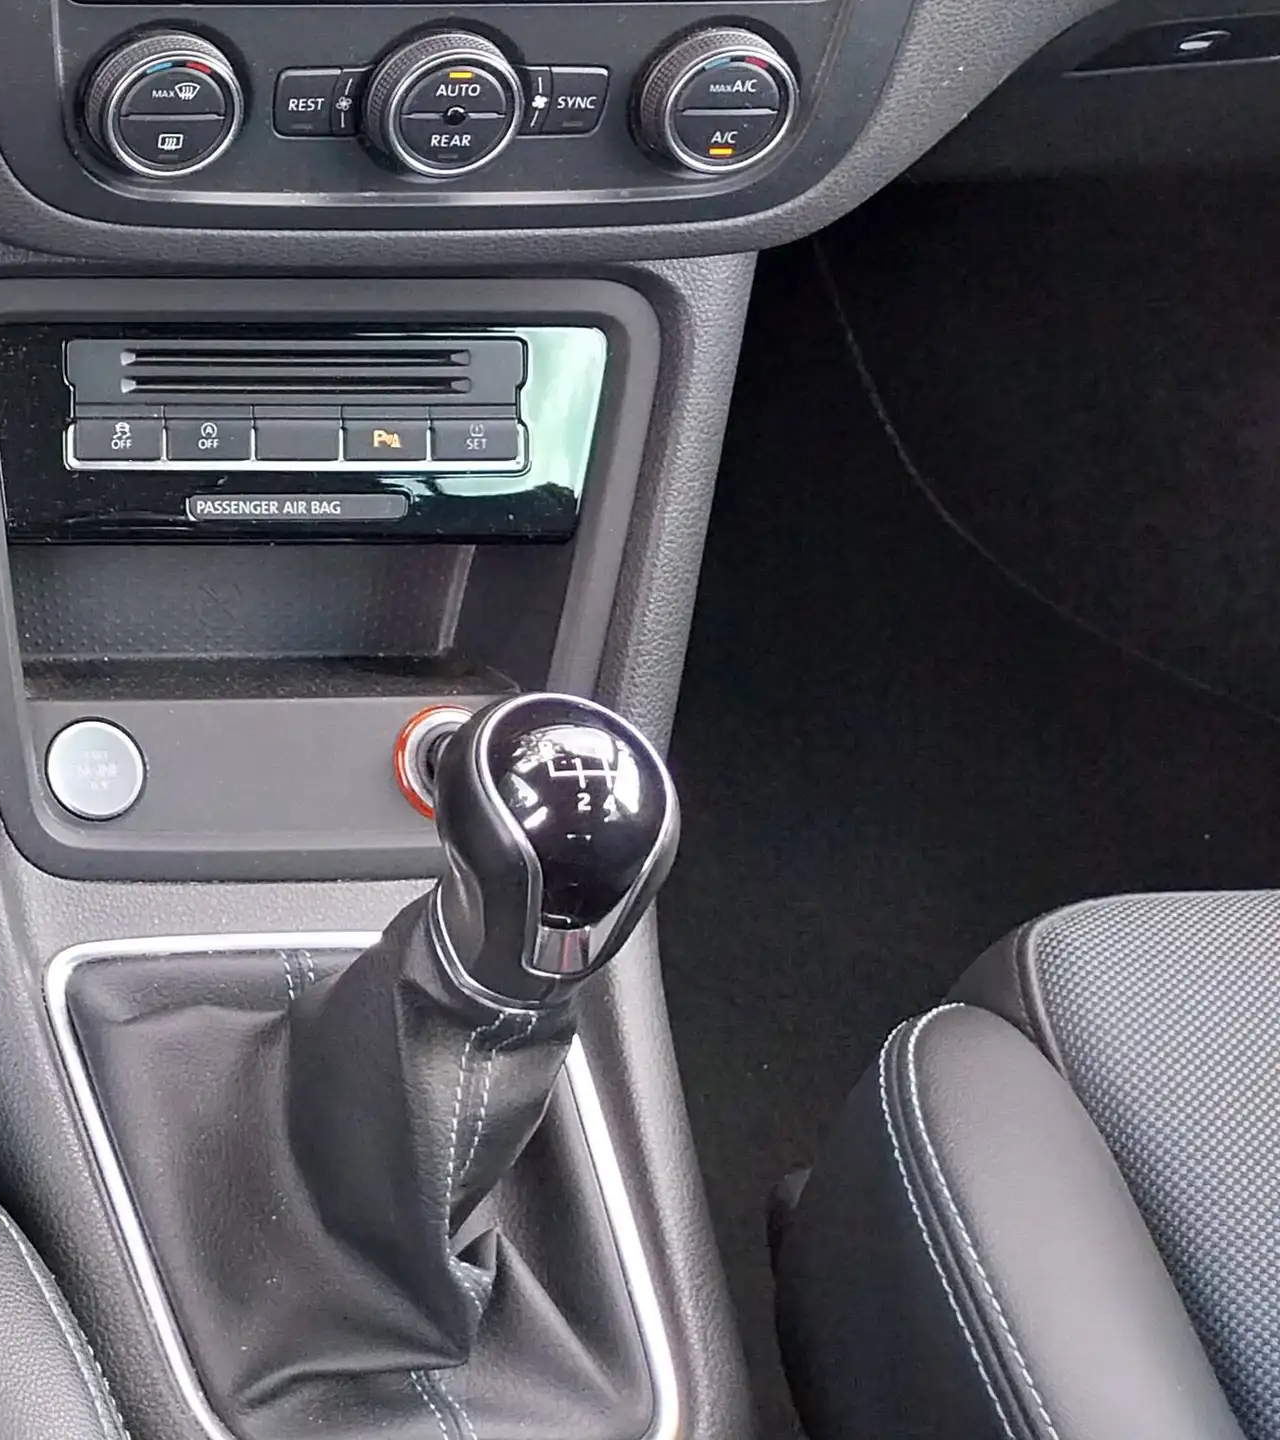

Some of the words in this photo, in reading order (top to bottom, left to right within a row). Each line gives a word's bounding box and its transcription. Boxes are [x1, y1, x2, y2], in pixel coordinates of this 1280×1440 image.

[152, 88, 175, 99] MAX
[436, 84, 481, 97] AUTO
[288, 98, 325, 112] REST
[557, 95, 597, 110] SYNC
[430, 134, 472, 148] REAR
[711, 131, 738, 144] A/C
[111, 439, 133, 450] OFF
[198, 438, 220, 450] OFF
[466, 438, 488, 450] SET
[196, 500, 280, 516] PASSENGER
[282, 500, 309, 516] AIR
[310, 500, 342, 516] BAG
[576, 792, 592, 812] 2
